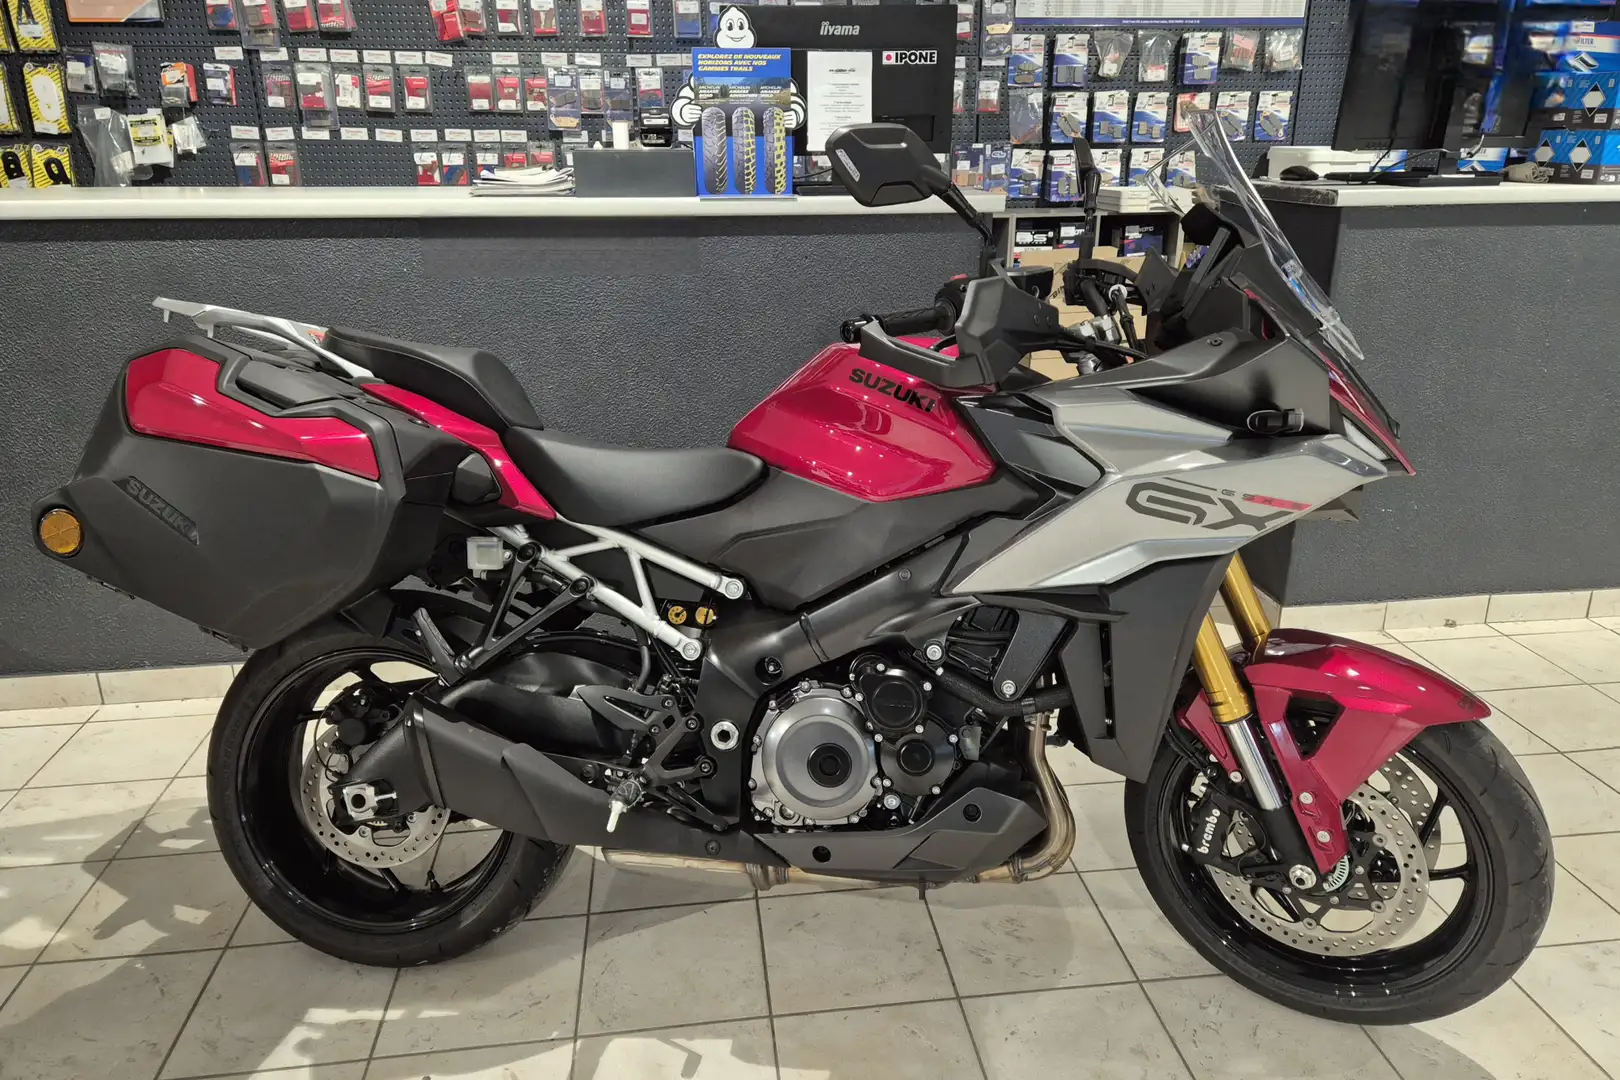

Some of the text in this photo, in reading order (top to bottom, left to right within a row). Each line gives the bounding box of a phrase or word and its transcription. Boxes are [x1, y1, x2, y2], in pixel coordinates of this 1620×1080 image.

[820, 21, 860, 35] iiyama
[895, 52, 936, 63] IPONE
[849, 368, 937, 413] SUZUKI
[126, 478, 198, 541] SUZUKI
[1196, 808, 1221, 855] brembo
